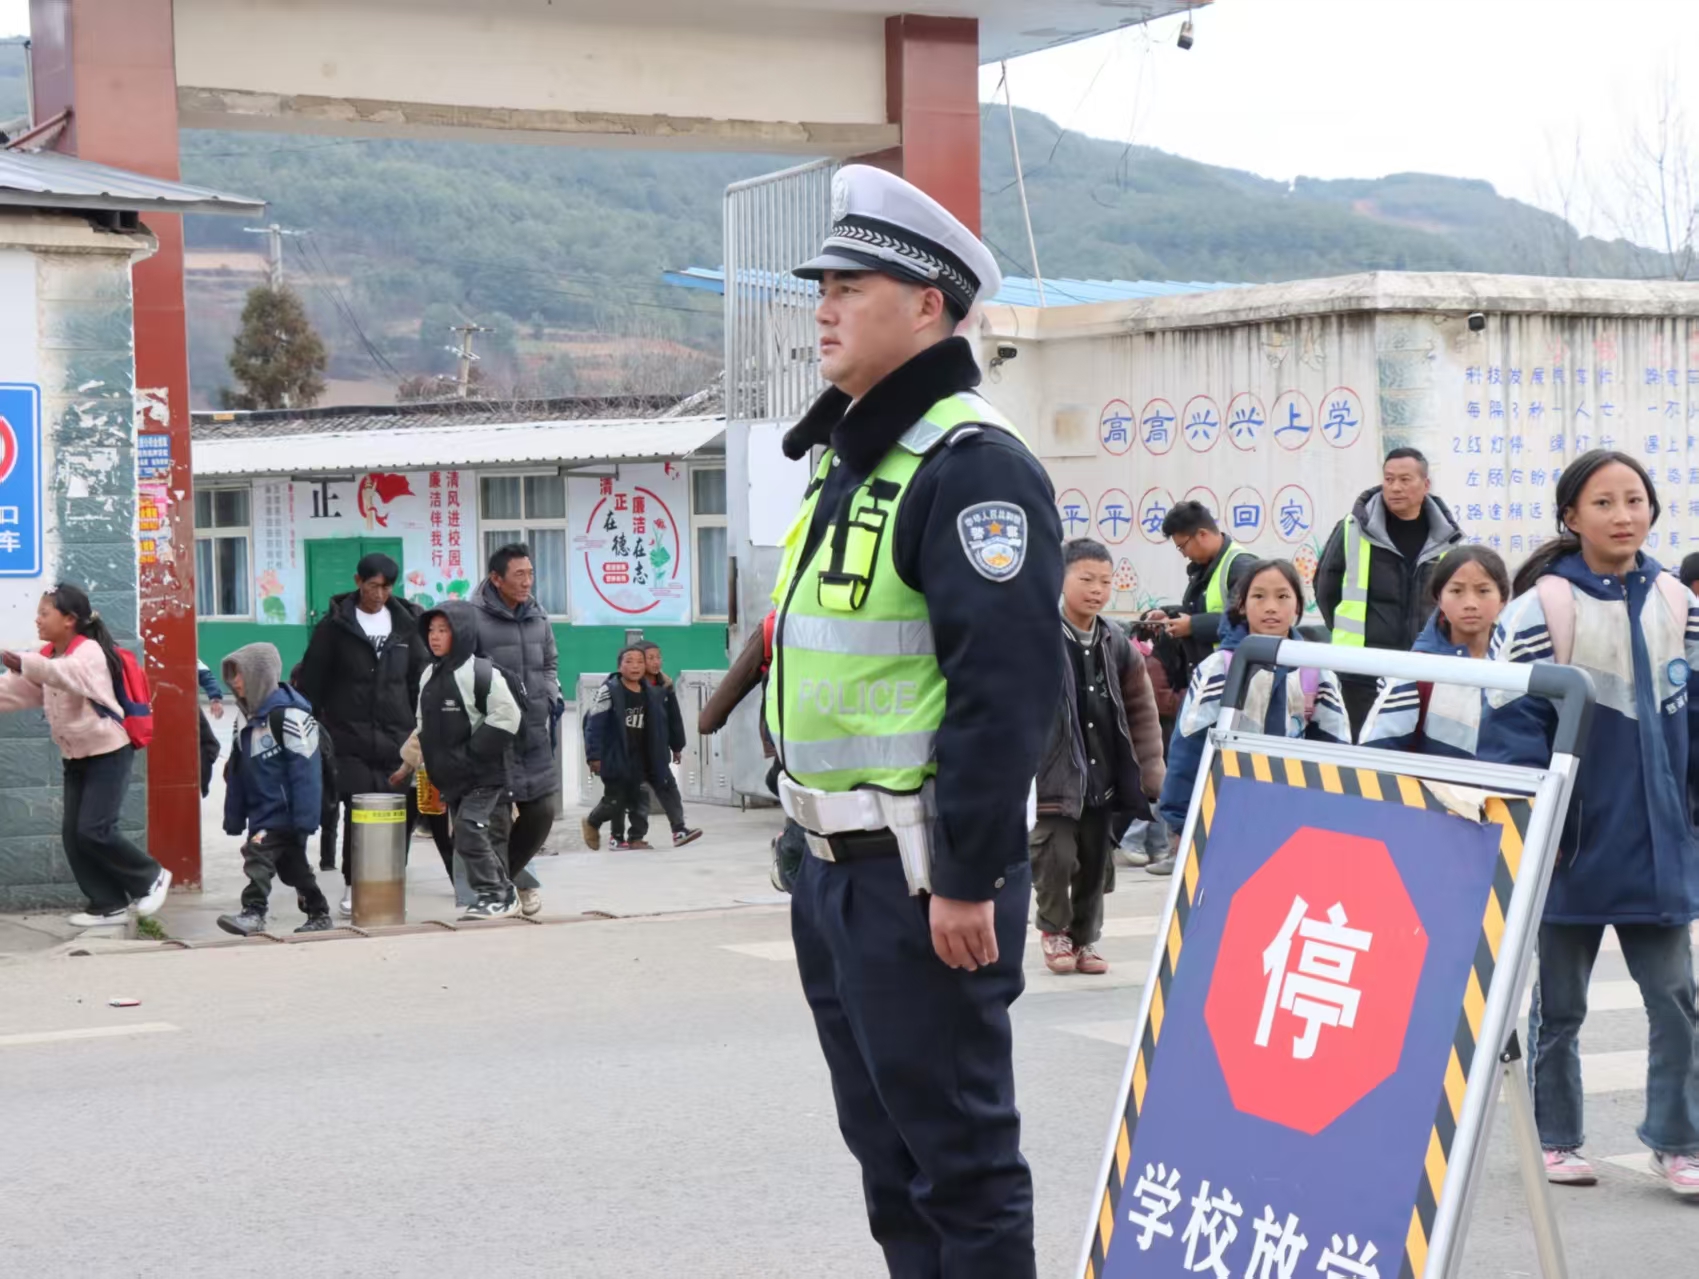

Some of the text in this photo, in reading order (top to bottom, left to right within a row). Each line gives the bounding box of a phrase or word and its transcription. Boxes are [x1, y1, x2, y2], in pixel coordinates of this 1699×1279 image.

[1102, 400, 1358, 445] 高高兴兴上学
[428, 470, 443, 567] 廉洁伴我行
[446, 470, 461, 566] 清风进校园
[1060, 498, 1309, 537] 平平安回家
[0, 530, 21, 553] 车
[797, 679, 916, 715] POLICE
[1253, 894, 1373, 1060] 停
